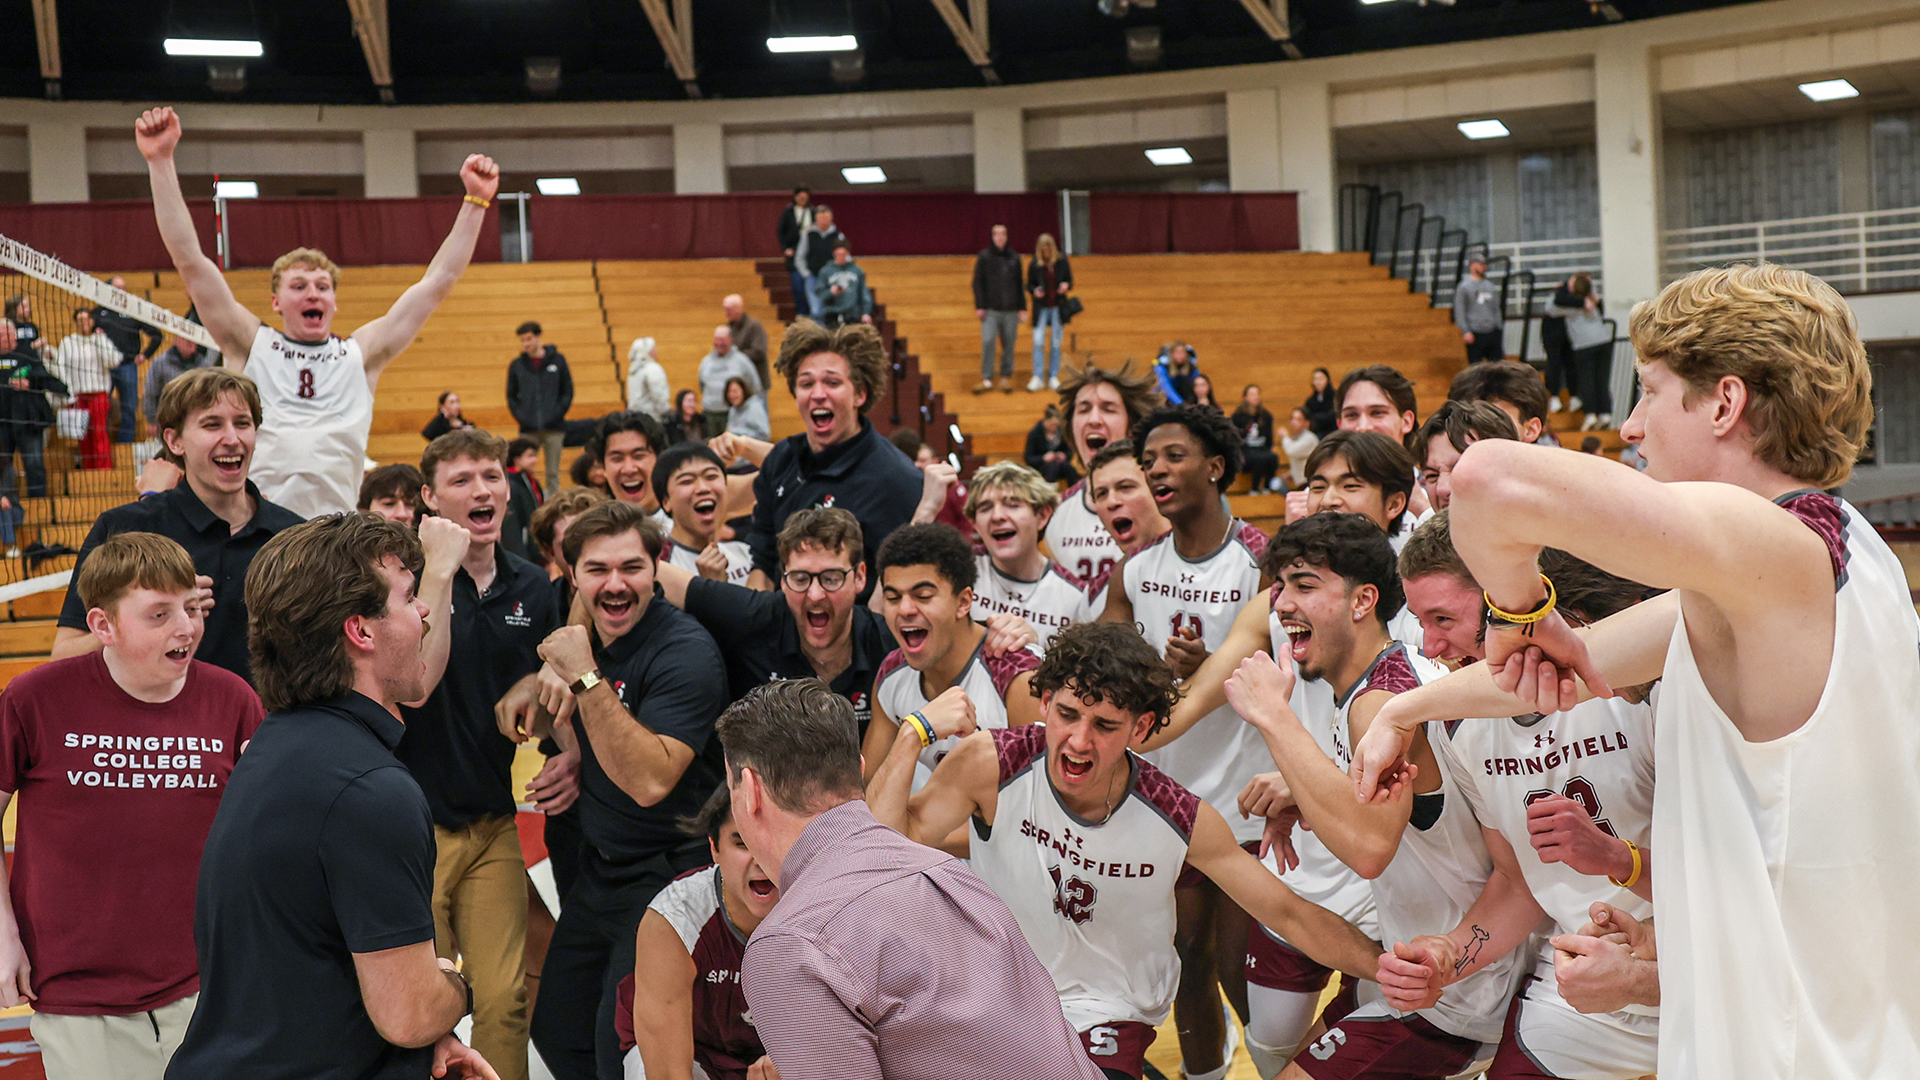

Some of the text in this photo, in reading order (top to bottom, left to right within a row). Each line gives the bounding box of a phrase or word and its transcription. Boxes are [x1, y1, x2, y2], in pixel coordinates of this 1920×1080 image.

[297, 367, 316, 400] 8
[972, 593, 1070, 627] PRINGFIELD
[64, 732, 224, 753] SPRINGFIELD
[93, 752, 202, 769] COLLEGE
[67, 770, 218, 789] VOLLEYBALL
[1047, 864, 1098, 926] 12
[1089, 1026, 1119, 1056] S
[1309, 1027, 1347, 1060] S
